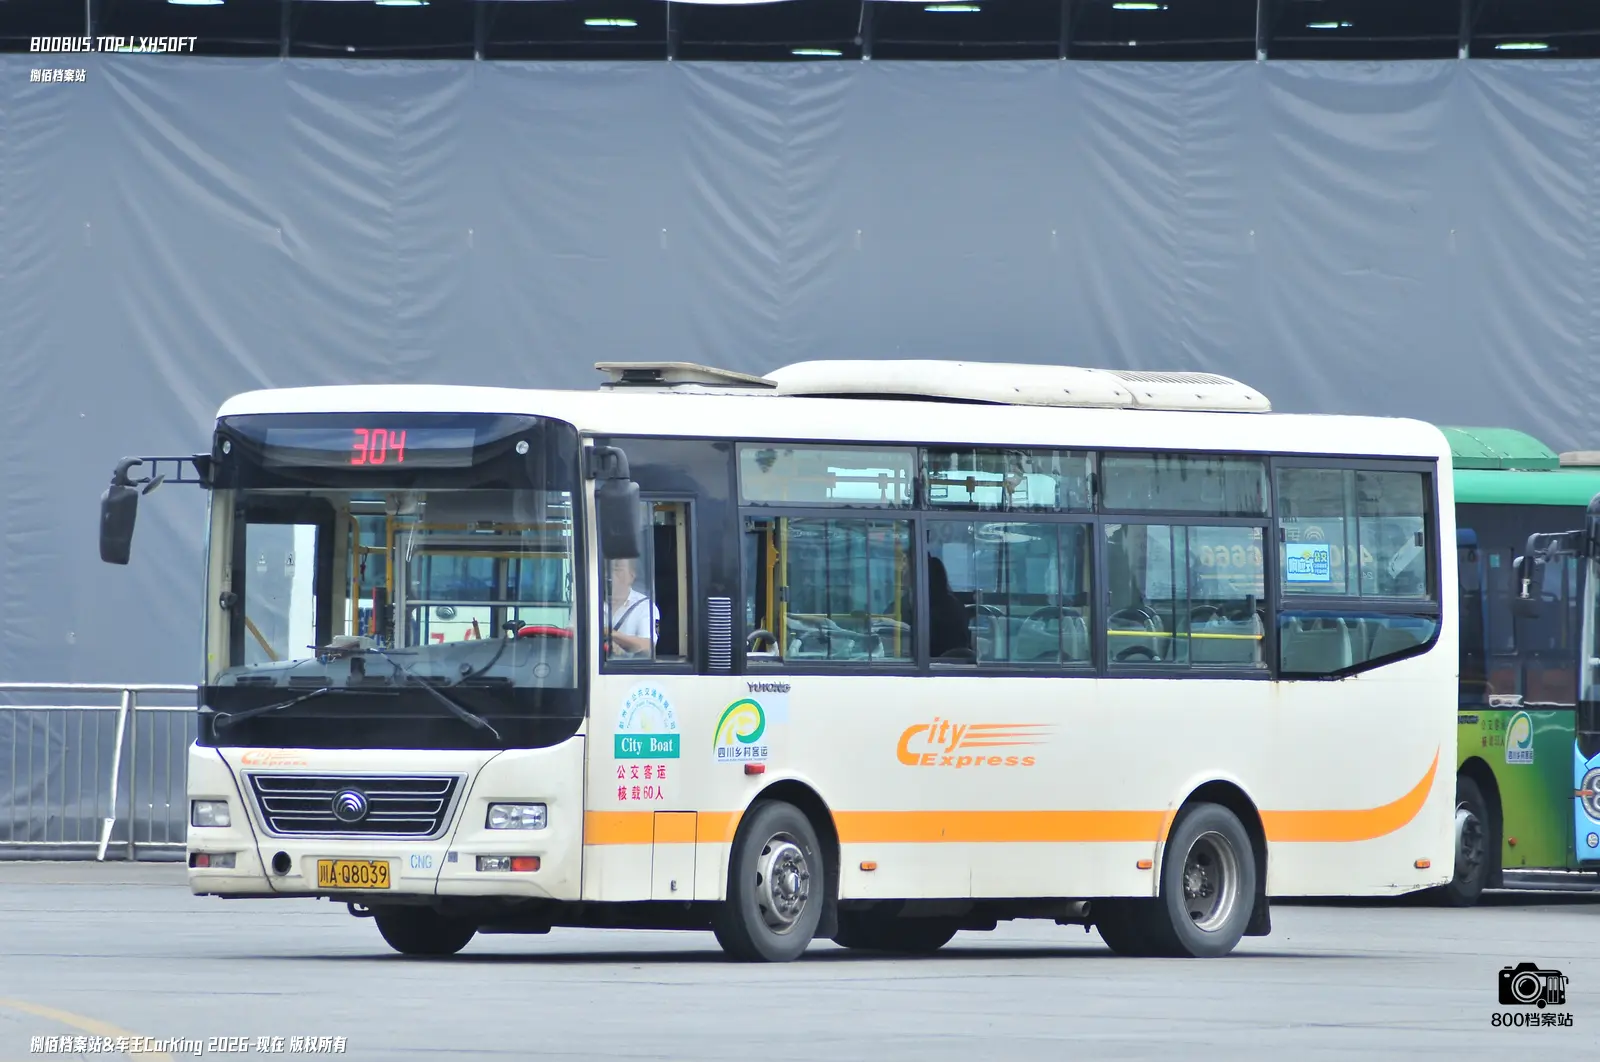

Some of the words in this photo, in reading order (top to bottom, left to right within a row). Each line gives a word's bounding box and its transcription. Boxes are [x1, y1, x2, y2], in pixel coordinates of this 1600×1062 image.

[351, 428, 406, 465] 304
[621, 737, 643, 755] City
[650, 737, 673, 752] Boat
[896, 717, 967, 766] City
[717, 746, 768, 758] 四川乡村客运
[920, 753, 1036, 769] Express
[617, 764, 666, 780] 公交客运
[617, 785, 664, 801] 核载60人
[410, 854, 432, 868] CNG
